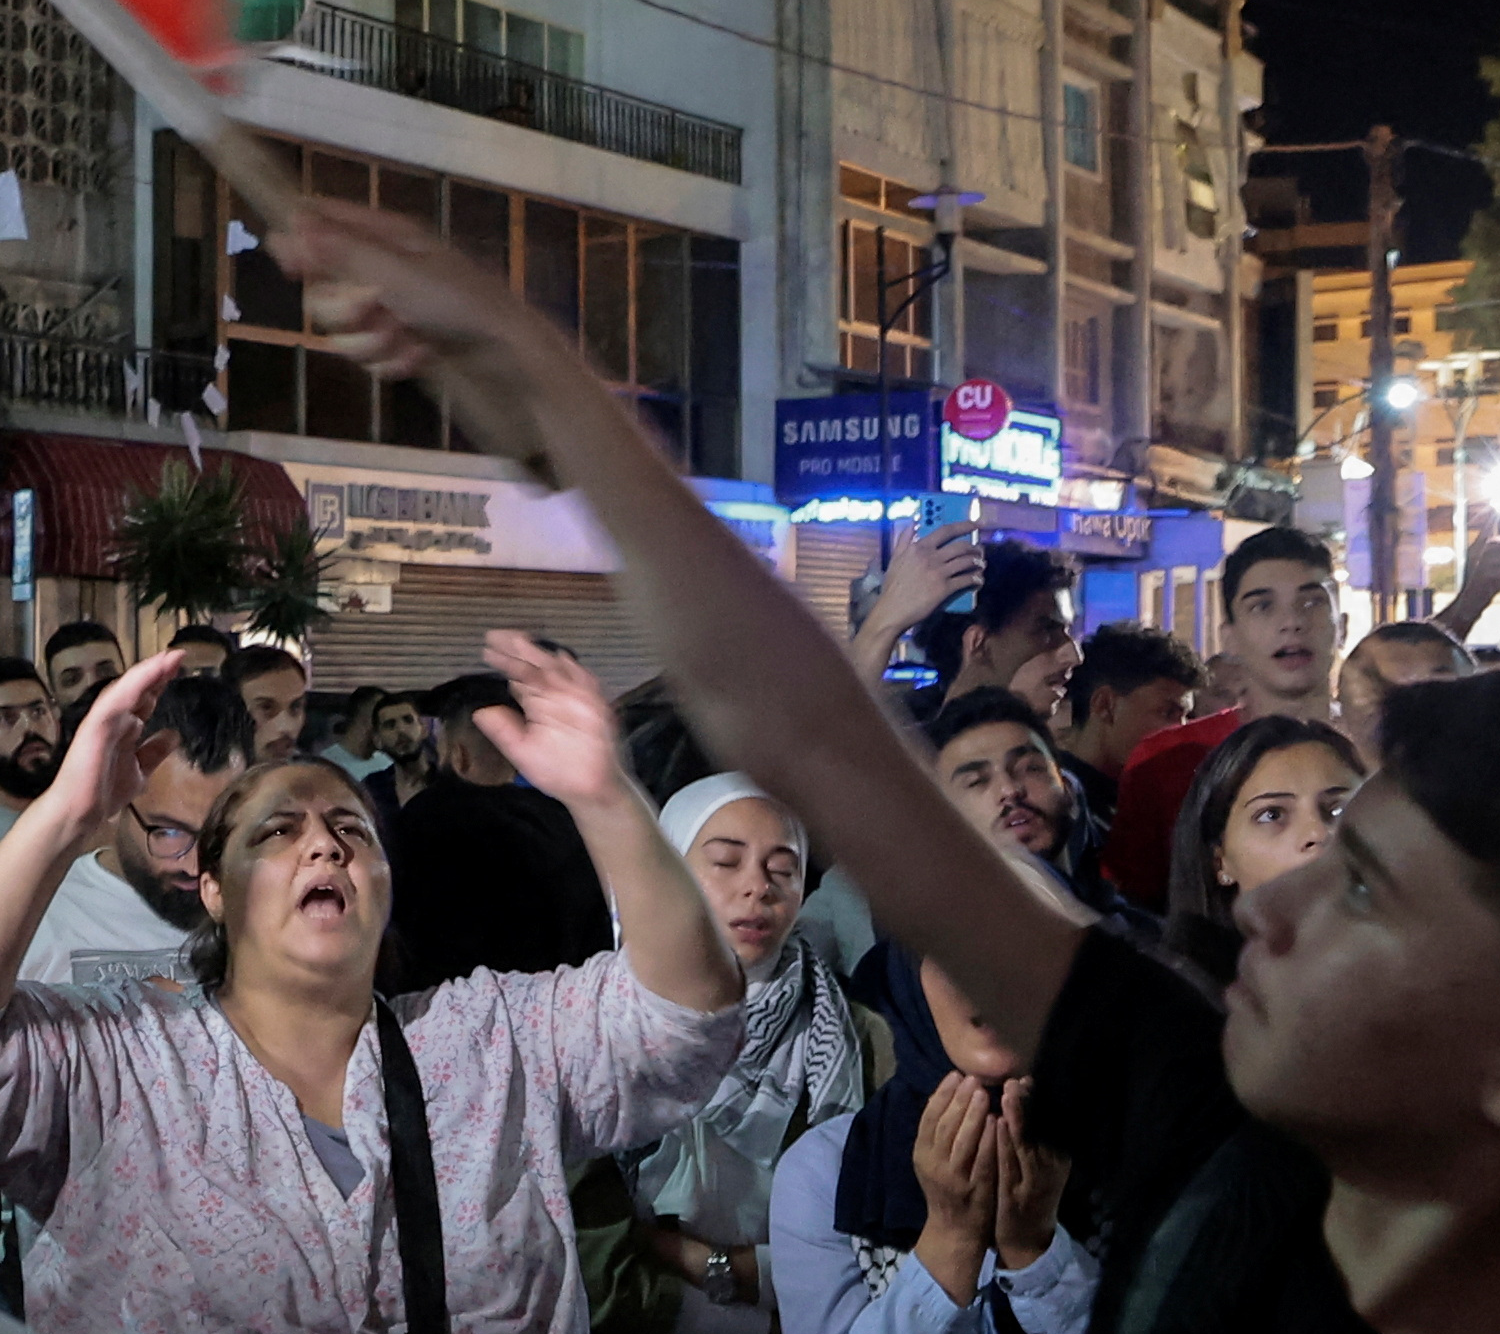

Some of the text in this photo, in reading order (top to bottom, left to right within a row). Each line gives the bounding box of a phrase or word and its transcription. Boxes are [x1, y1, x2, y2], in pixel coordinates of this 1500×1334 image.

[956, 385, 993, 410] CU
[783, 413, 920, 445] SAMSUNG
[837, 454, 902, 475] MOBIE
